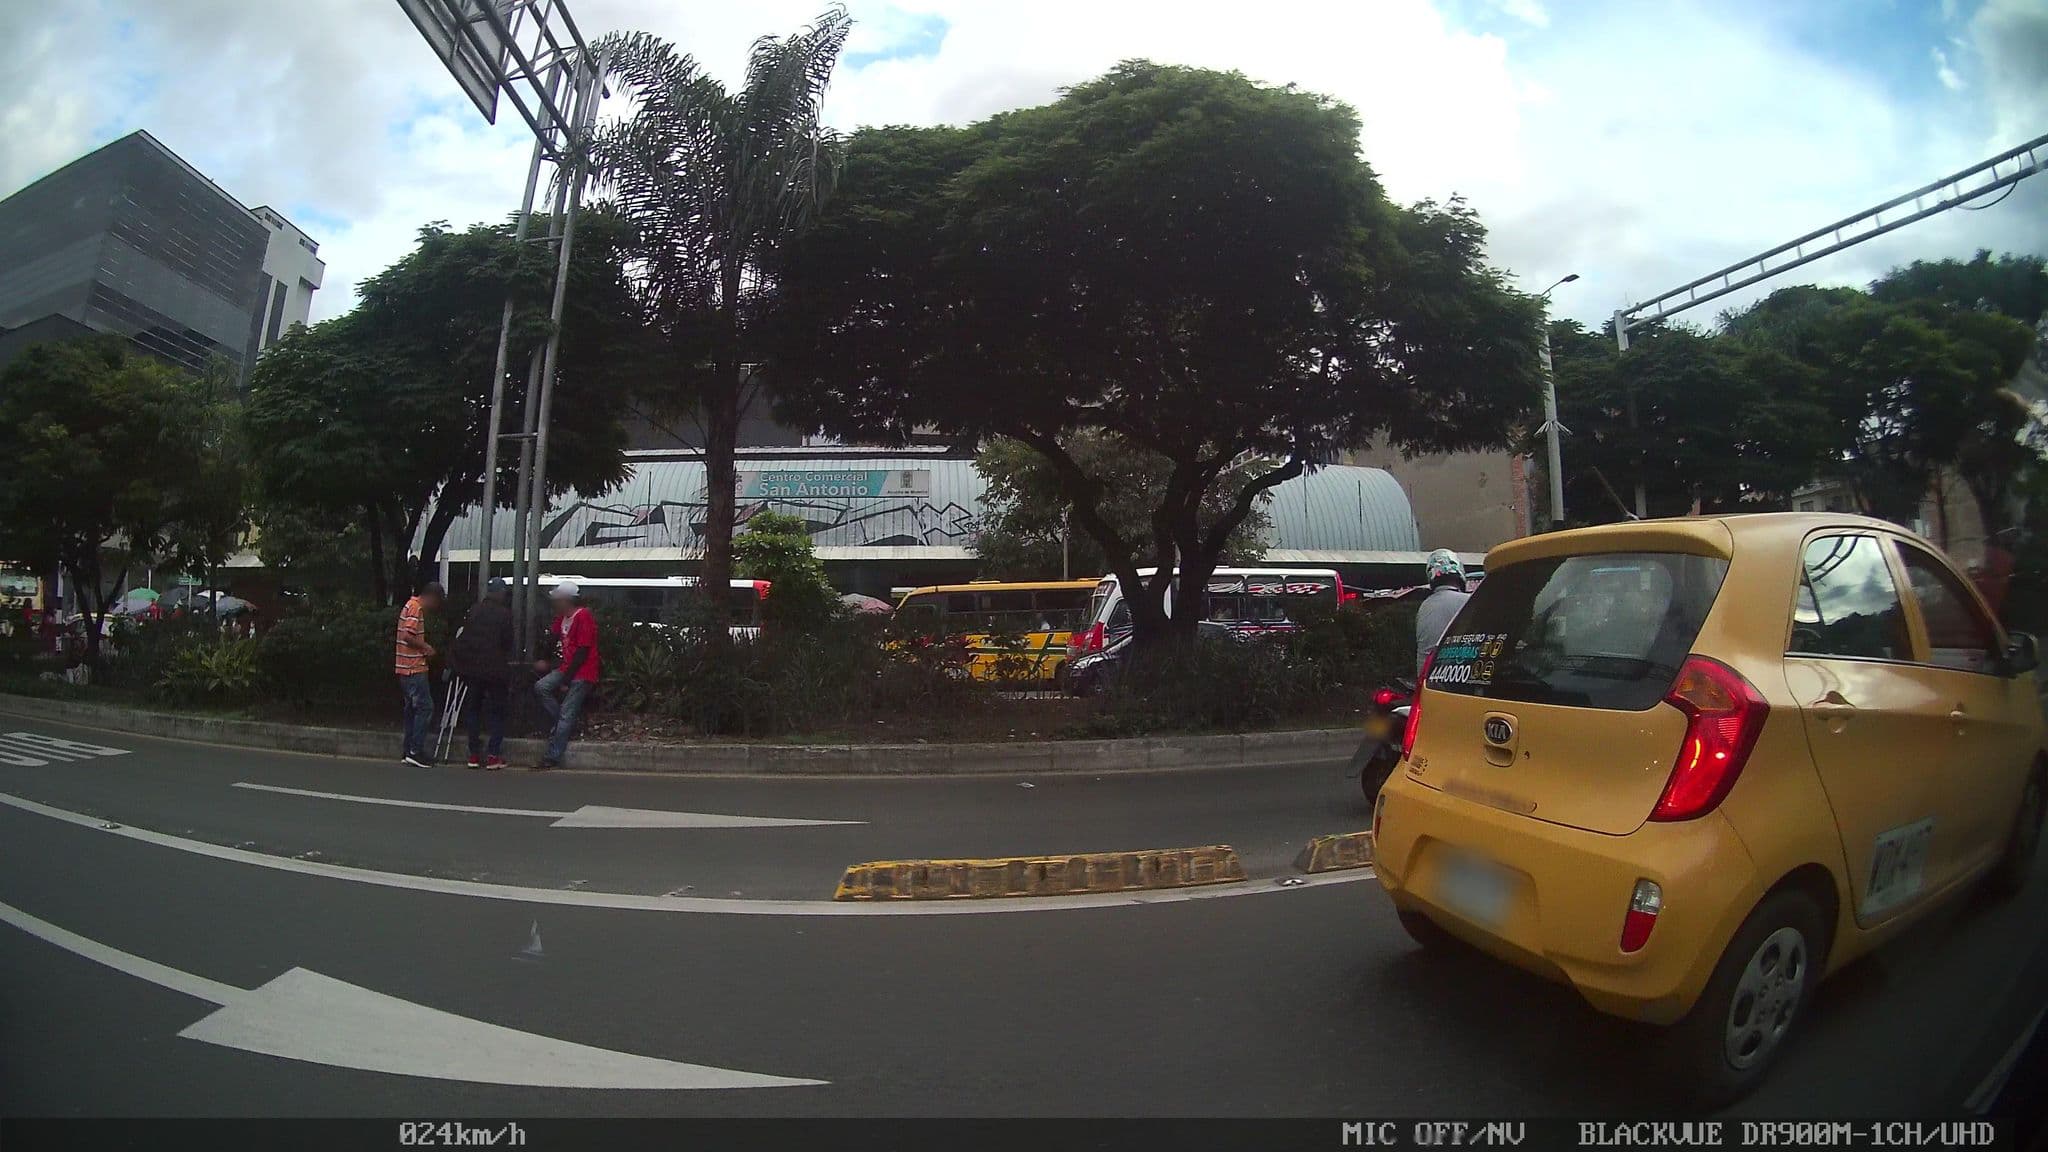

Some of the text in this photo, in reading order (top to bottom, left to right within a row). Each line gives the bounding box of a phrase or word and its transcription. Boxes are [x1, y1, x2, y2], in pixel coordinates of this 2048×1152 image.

[760, 471, 868, 482] Centro Comercial
[759, 482, 790, 496] San
[795, 482, 868, 496] Antonio
[1429, 665, 1471, 683] 4440000
[1487, 722, 1507, 740] KIA
